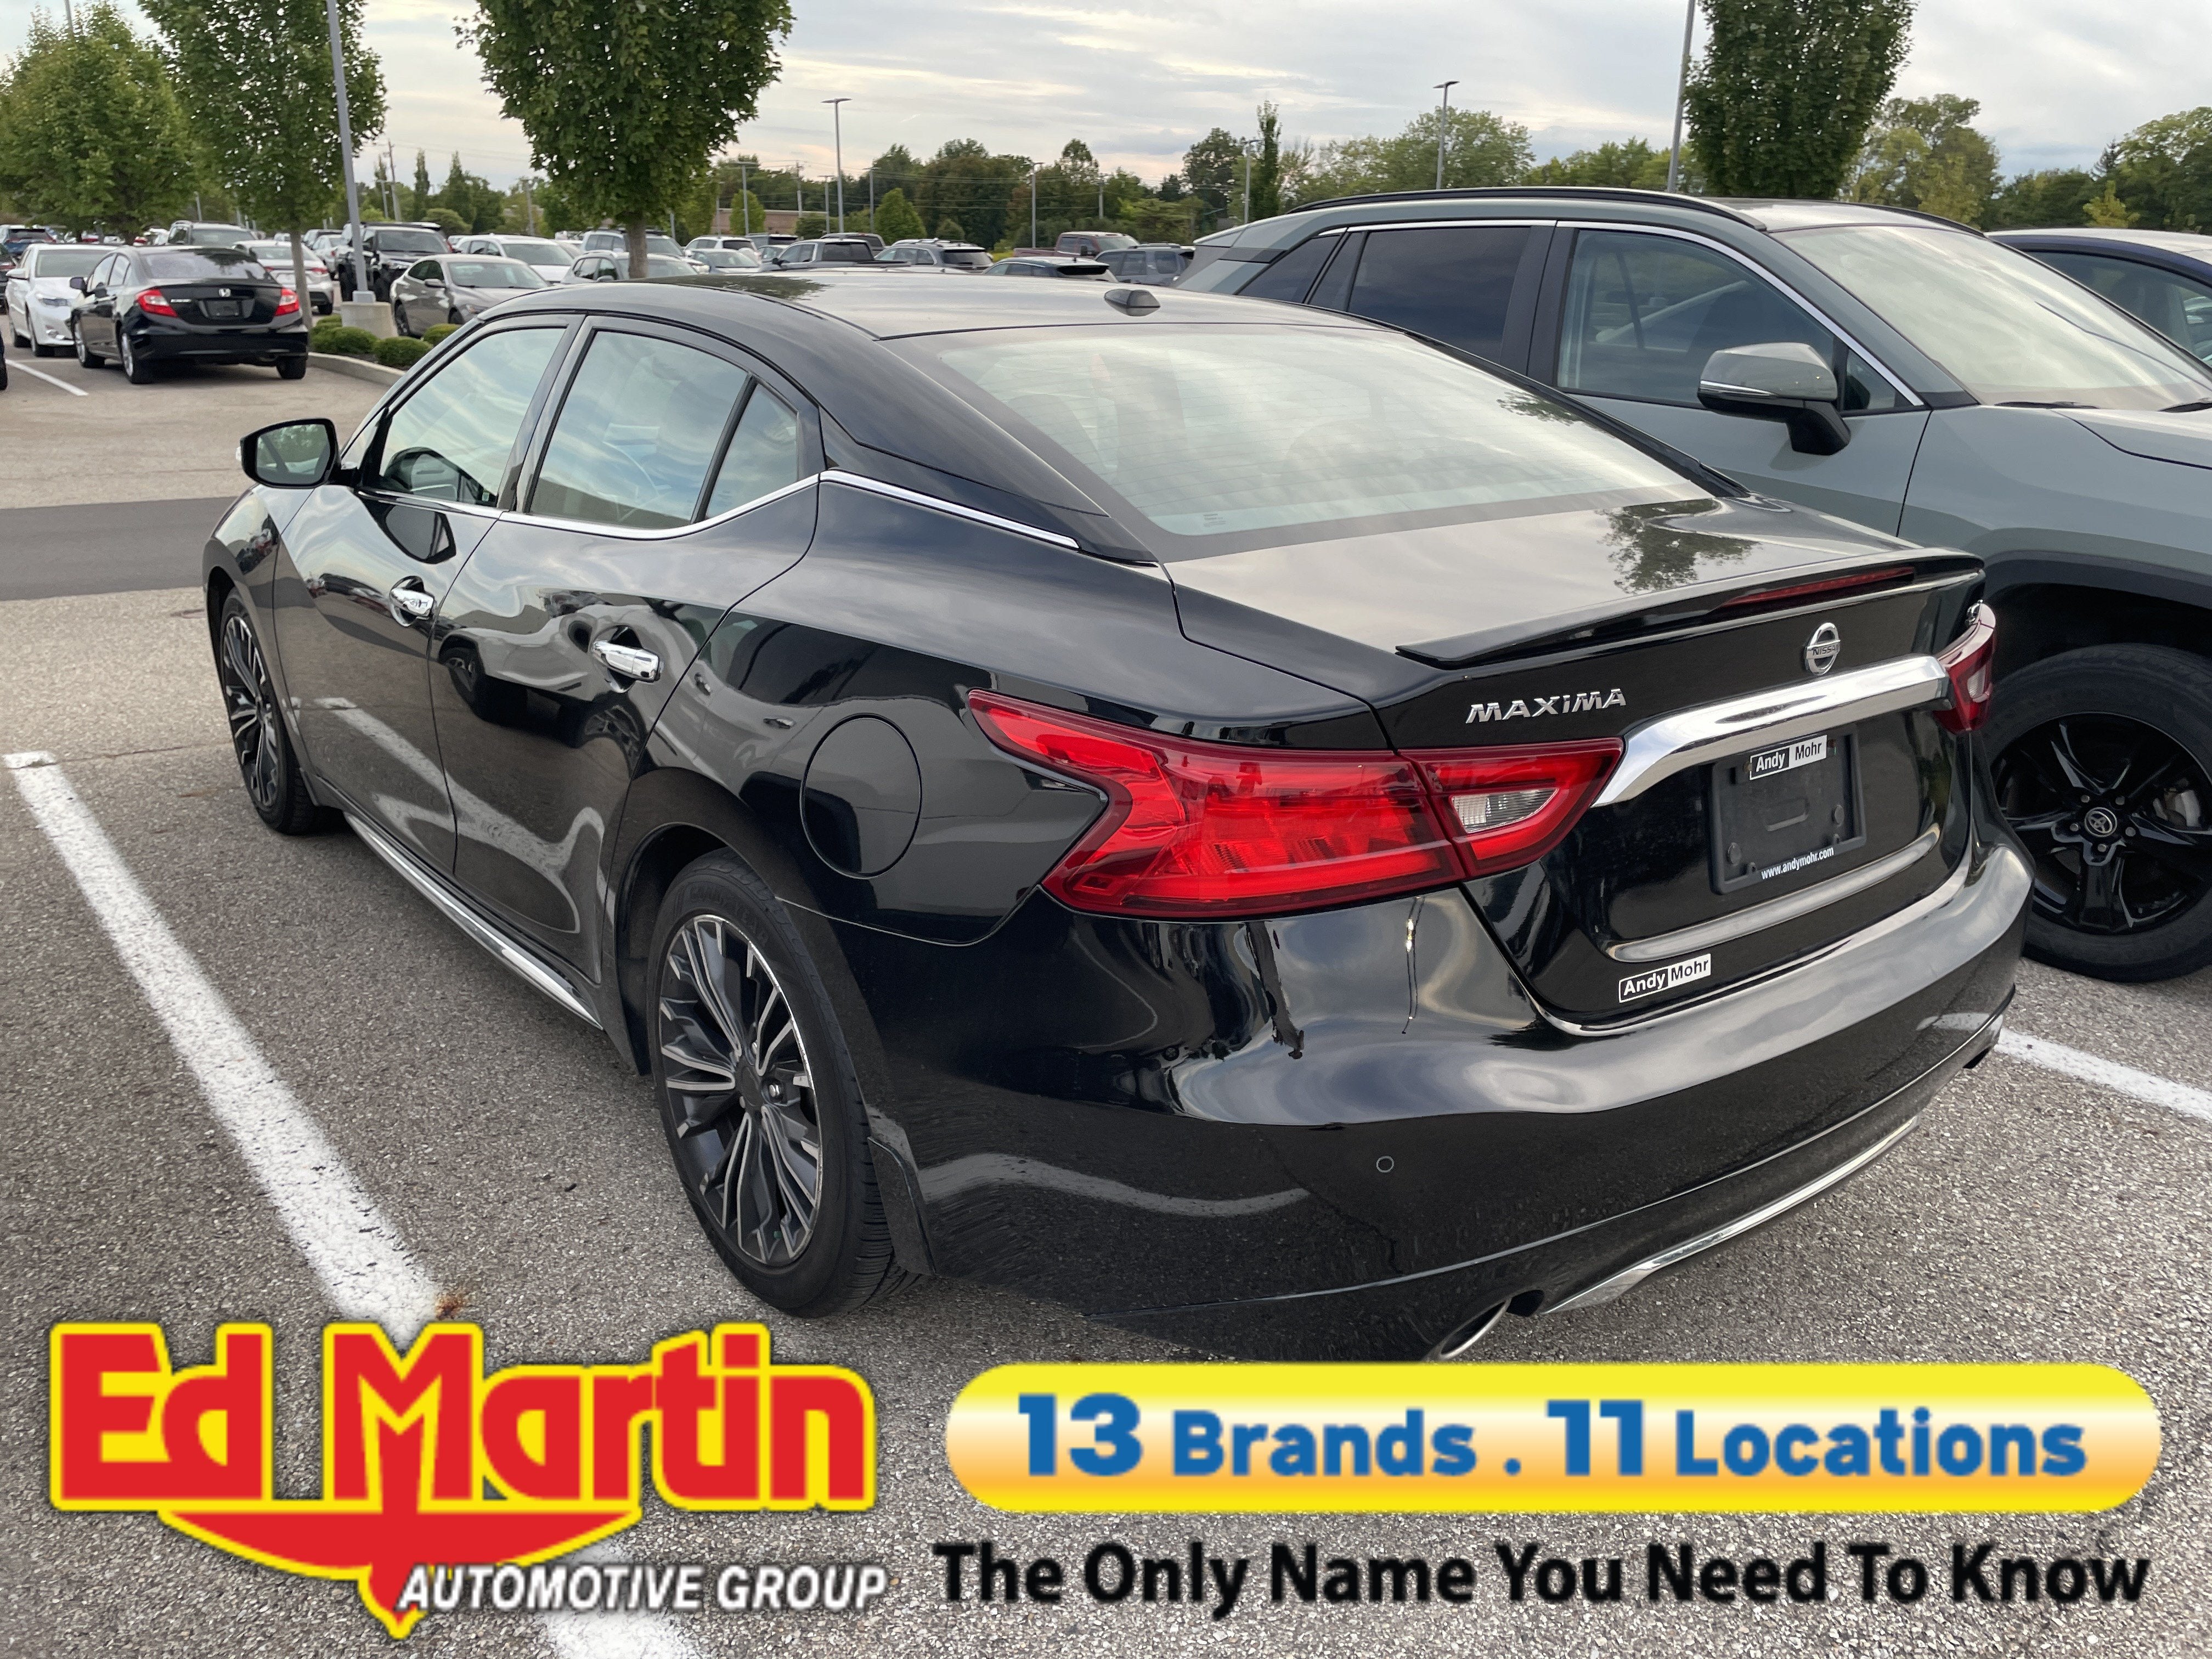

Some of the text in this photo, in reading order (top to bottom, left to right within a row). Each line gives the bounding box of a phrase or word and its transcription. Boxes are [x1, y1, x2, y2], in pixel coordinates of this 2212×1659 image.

[1465, 688, 1627, 724] MAXIMA
[1756, 742, 1822, 772] Andy Mohr
[1761, 847, 1834, 879] www.andymohr.com
[1623, 960, 1708, 996] Andy Mohr
